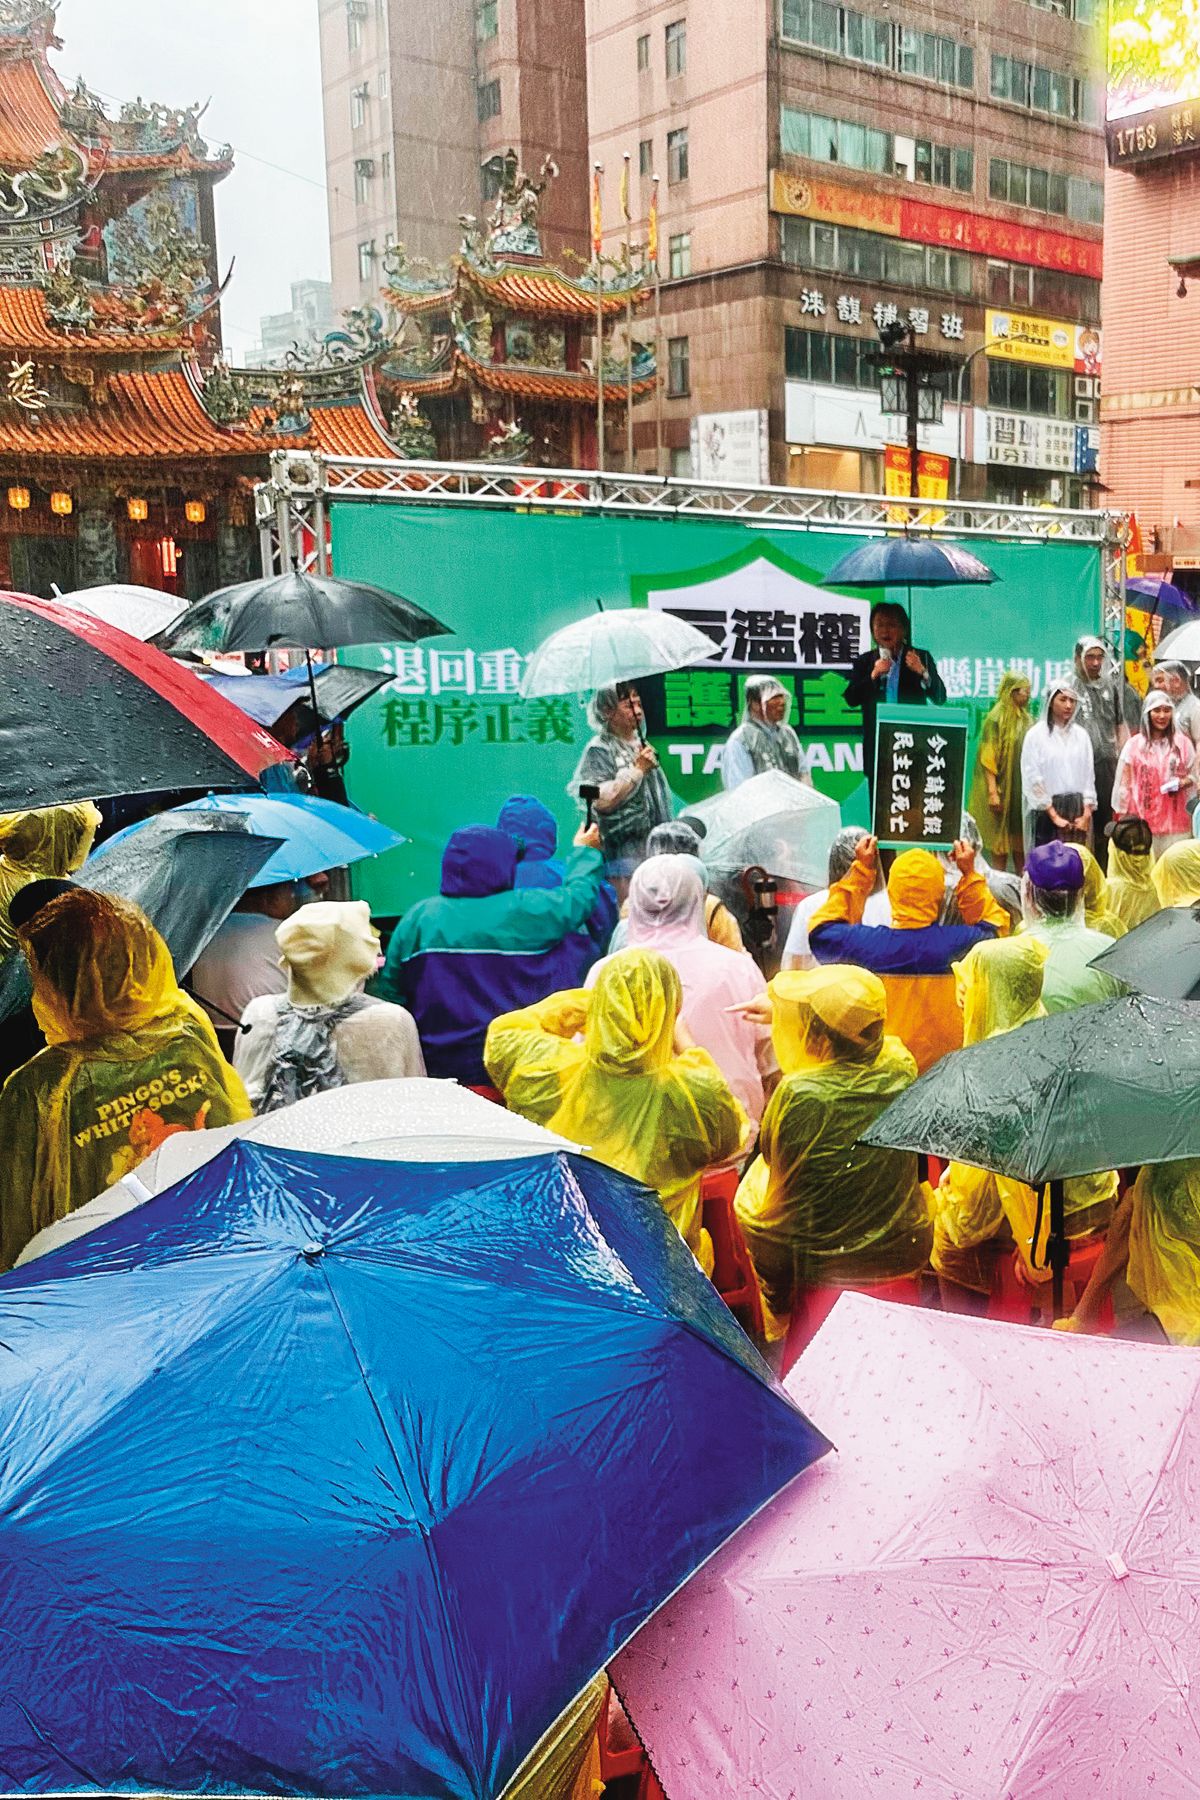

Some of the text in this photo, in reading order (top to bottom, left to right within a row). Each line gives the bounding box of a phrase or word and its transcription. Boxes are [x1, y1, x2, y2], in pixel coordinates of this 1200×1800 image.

[1116, 123, 1158, 156] 1753
[377, 646, 535, 696] 退回重
[380, 697, 575, 747] 程序正義
[665, 671, 864, 728] 護主
[668, 743, 864, 775] TAAN
[890, 731, 914, 834] 民主已死亡
[96, 1069, 182, 1120] PINGO'S
